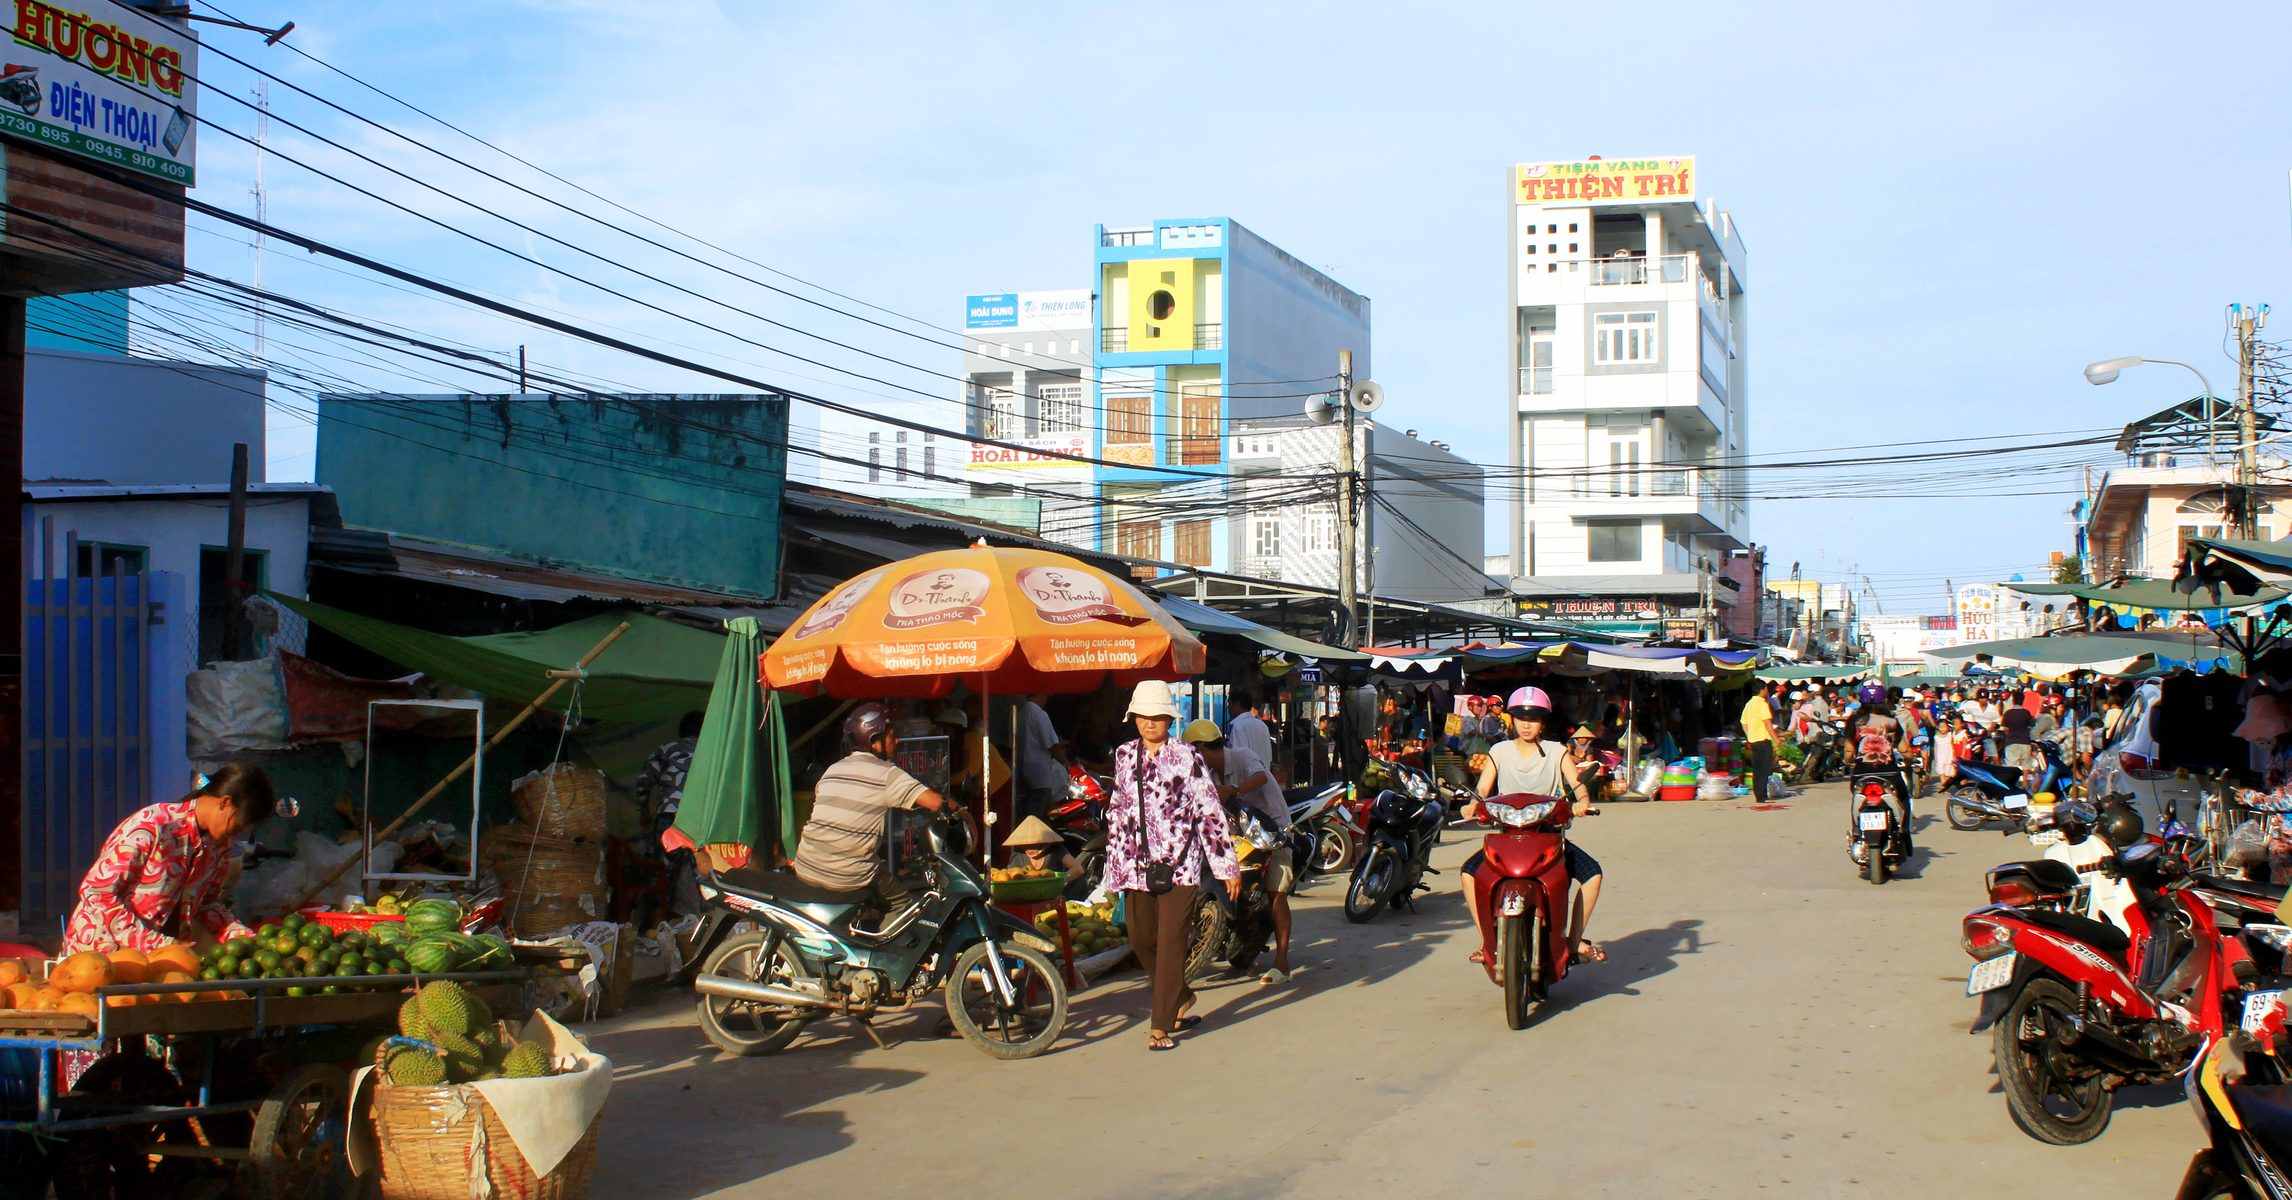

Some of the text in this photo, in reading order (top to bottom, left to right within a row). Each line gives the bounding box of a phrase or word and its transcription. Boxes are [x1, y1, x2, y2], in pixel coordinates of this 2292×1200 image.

[15, 0, 184, 98] HƯƠNG
[51, 80, 157, 152] ĐIỆN THOẠI
[41, 126, 70, 144] 895
[132, 152, 156, 169] 910
[160, 162, 186, 178] 409
[1522, 169, 1688, 200] THIỆN TRÍ
[2257, 1153, 2292, 1200] JUPI
